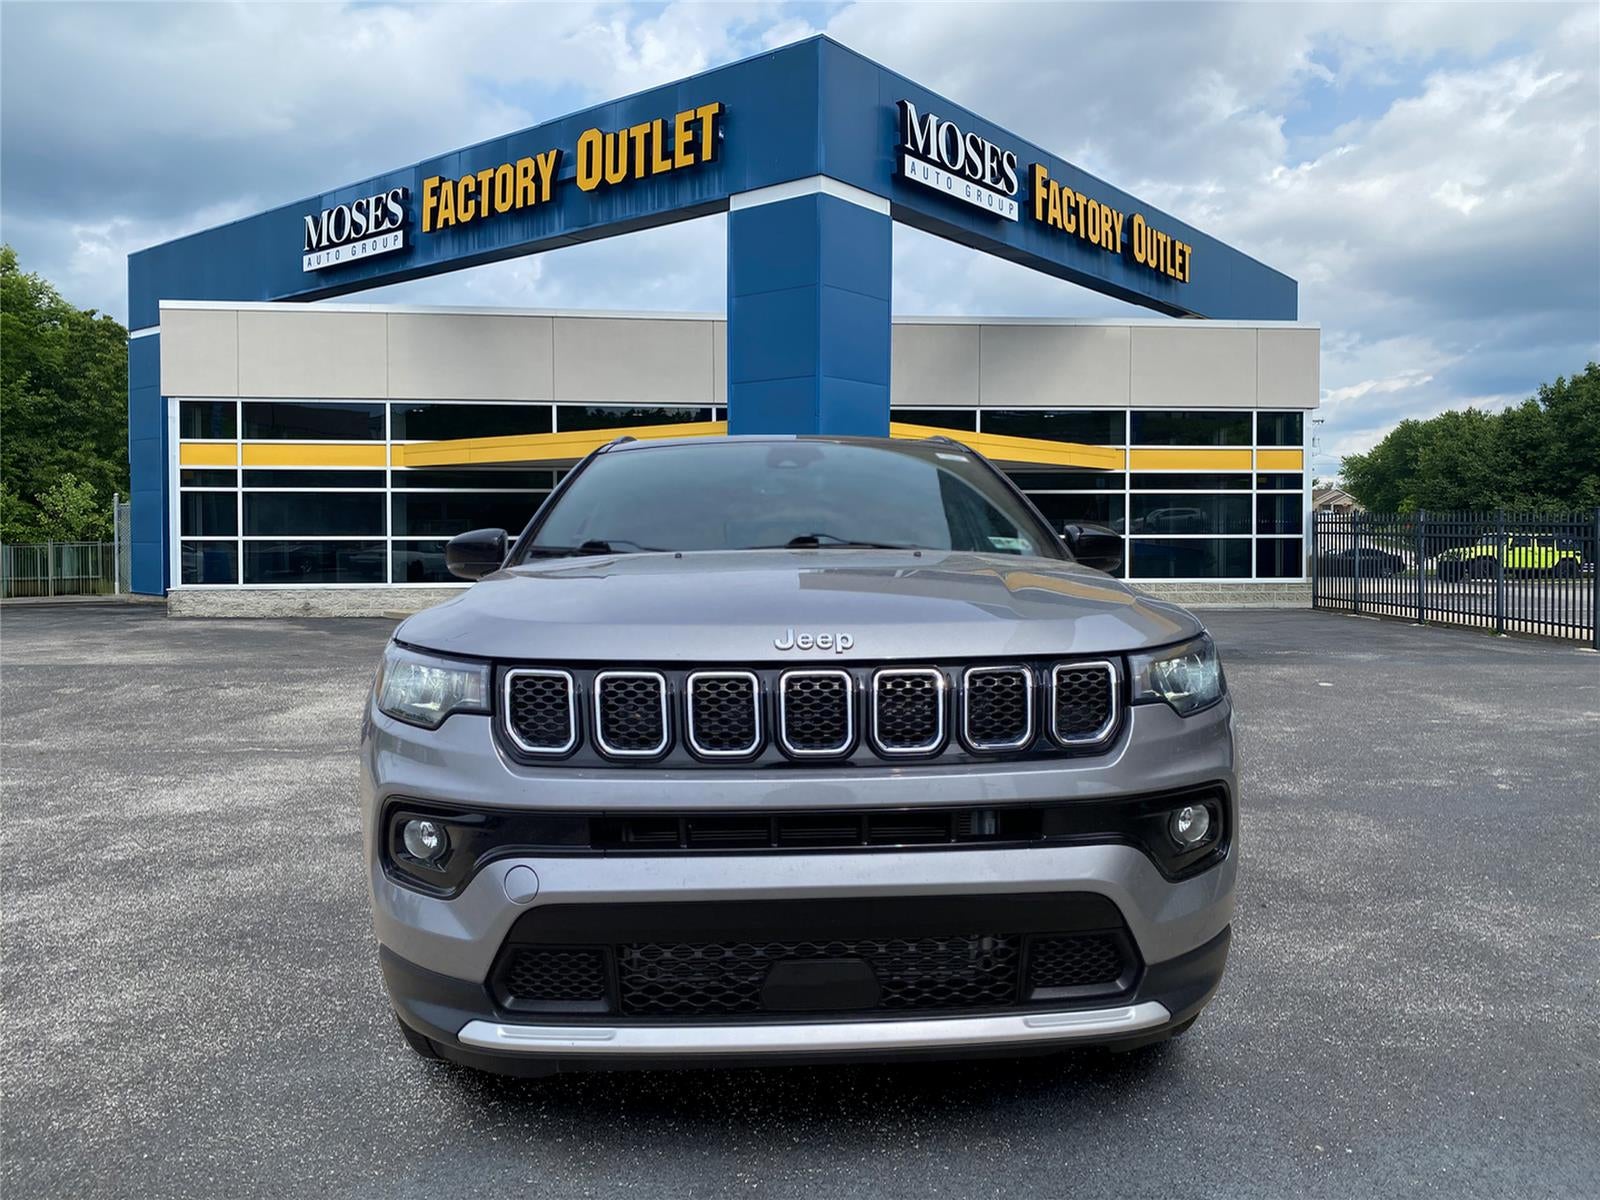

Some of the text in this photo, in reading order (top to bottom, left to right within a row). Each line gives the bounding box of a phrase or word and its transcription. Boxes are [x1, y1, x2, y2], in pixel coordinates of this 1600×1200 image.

[904, 100, 1019, 196] MOSES
[910, 161, 1015, 214] AUTO GROUP
[303, 187, 404, 251] MOSES
[307, 234, 399, 268] AUTO GROUP
[774, 627, 855, 654] Jeep
